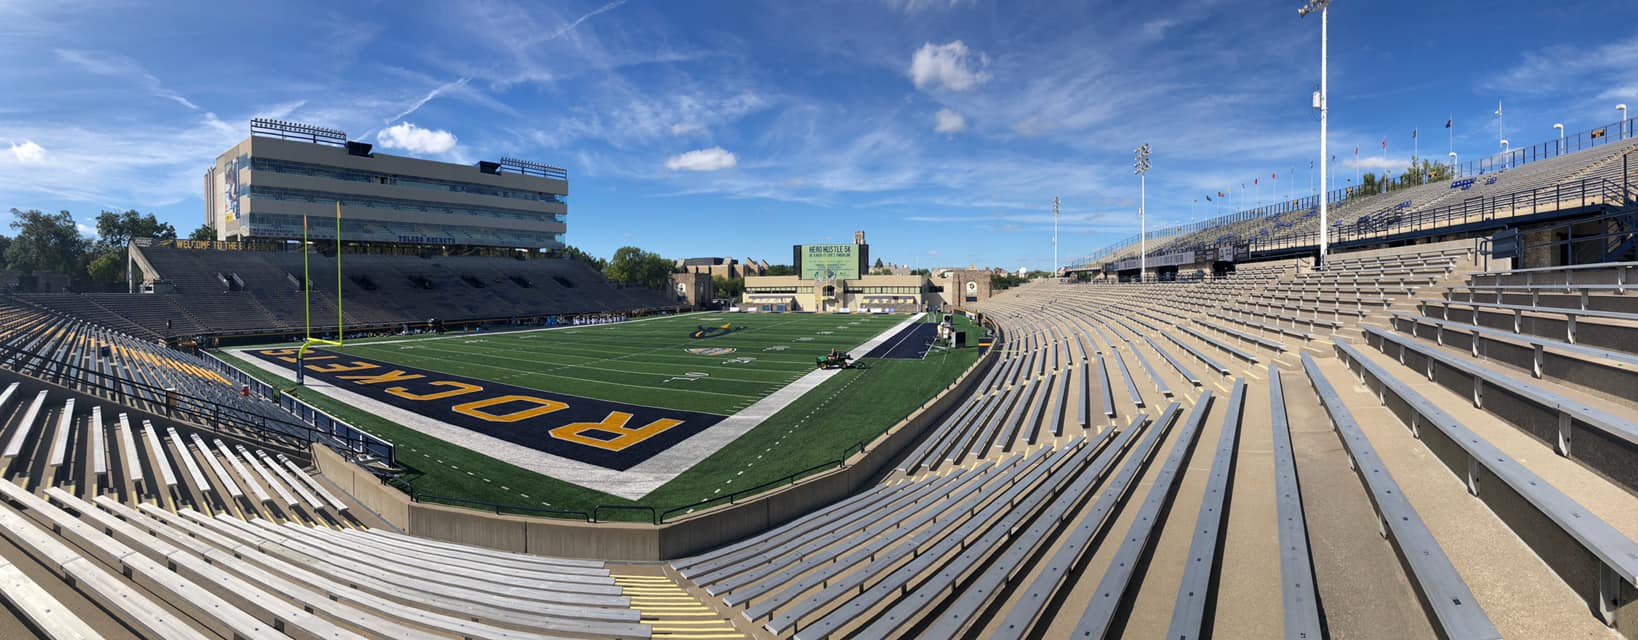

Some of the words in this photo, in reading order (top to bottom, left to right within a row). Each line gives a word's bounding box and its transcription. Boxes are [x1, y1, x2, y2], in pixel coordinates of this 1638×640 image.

[176, 240, 210, 249] WELCOME
[214, 241, 223, 250] TO
[224, 242, 237, 250] THE
[260, 349, 686, 452] ROCKETS
